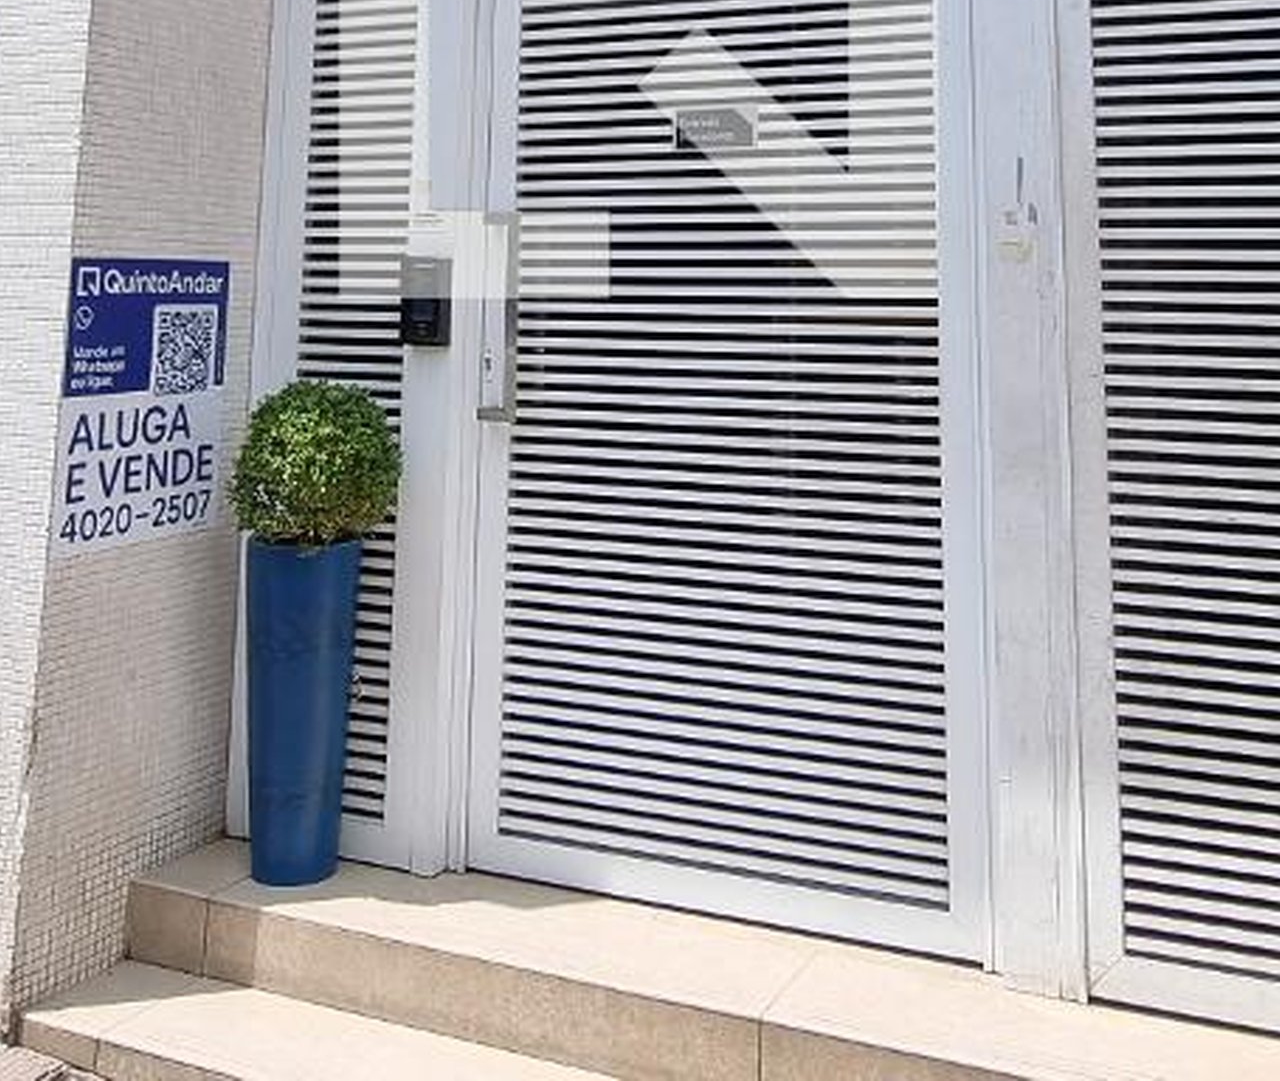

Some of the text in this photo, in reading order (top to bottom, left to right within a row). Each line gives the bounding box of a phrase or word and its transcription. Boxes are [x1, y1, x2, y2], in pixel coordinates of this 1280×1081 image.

[104, 269, 224, 294] QuintoAndar
[68, 403, 191, 455] ALUGA
[65, 444, 213, 505] E VENDE
[60, 490, 212, 543] 4020-2507
